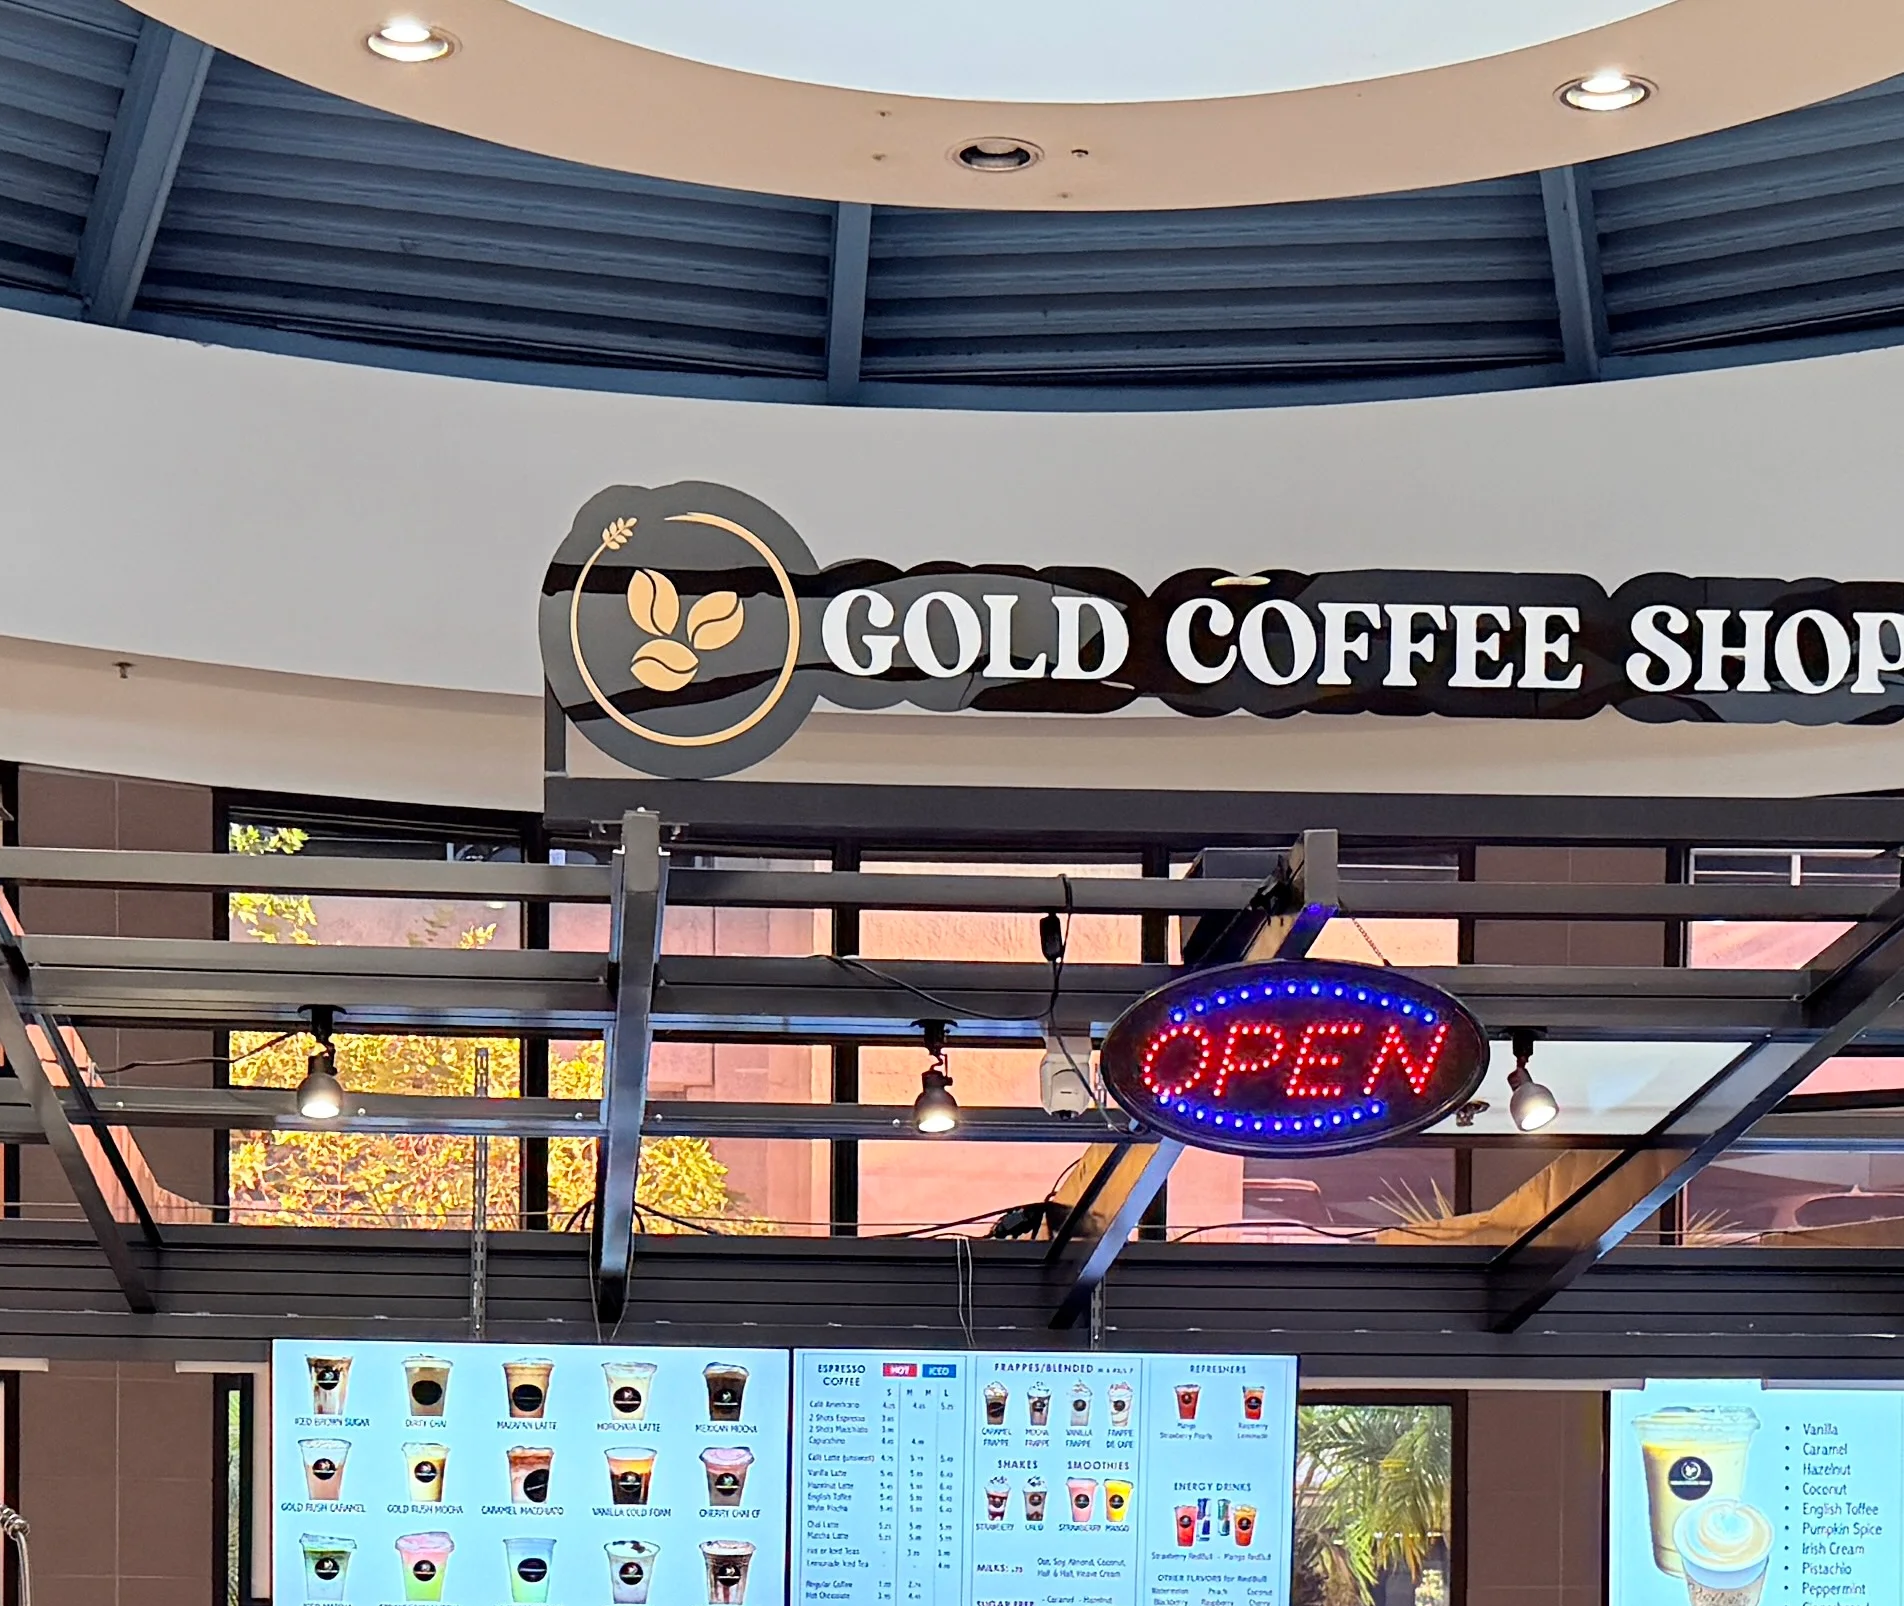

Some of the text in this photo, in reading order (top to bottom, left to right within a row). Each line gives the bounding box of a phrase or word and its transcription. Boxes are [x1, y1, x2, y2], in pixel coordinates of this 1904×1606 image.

[821, 588, 1130, 681] GOLD
[1165, 597, 1584, 690] COFFEE
[1139, 1019, 1452, 1098] OPEN
[818, 1364, 865, 1374] ESPRESSO
[823, 1377, 860, 1386] COFFEE
[1802, 1423, 1838, 1435] Vanilla
[1802, 1442, 1848, 1455] Caramel
[1803, 1462, 1851, 1475] Hazelnut
[1802, 1482, 1847, 1495] Coconut
[1802, 1502, 1879, 1519] English Toffee
[1802, 1522, 1883, 1539] Pumpkin Spice
[1802, 1542, 1865, 1555] Irish Cream
[1802, 1562, 1852, 1575] Pistachio
[1802, 1581, 1866, 1598] Peppermint
